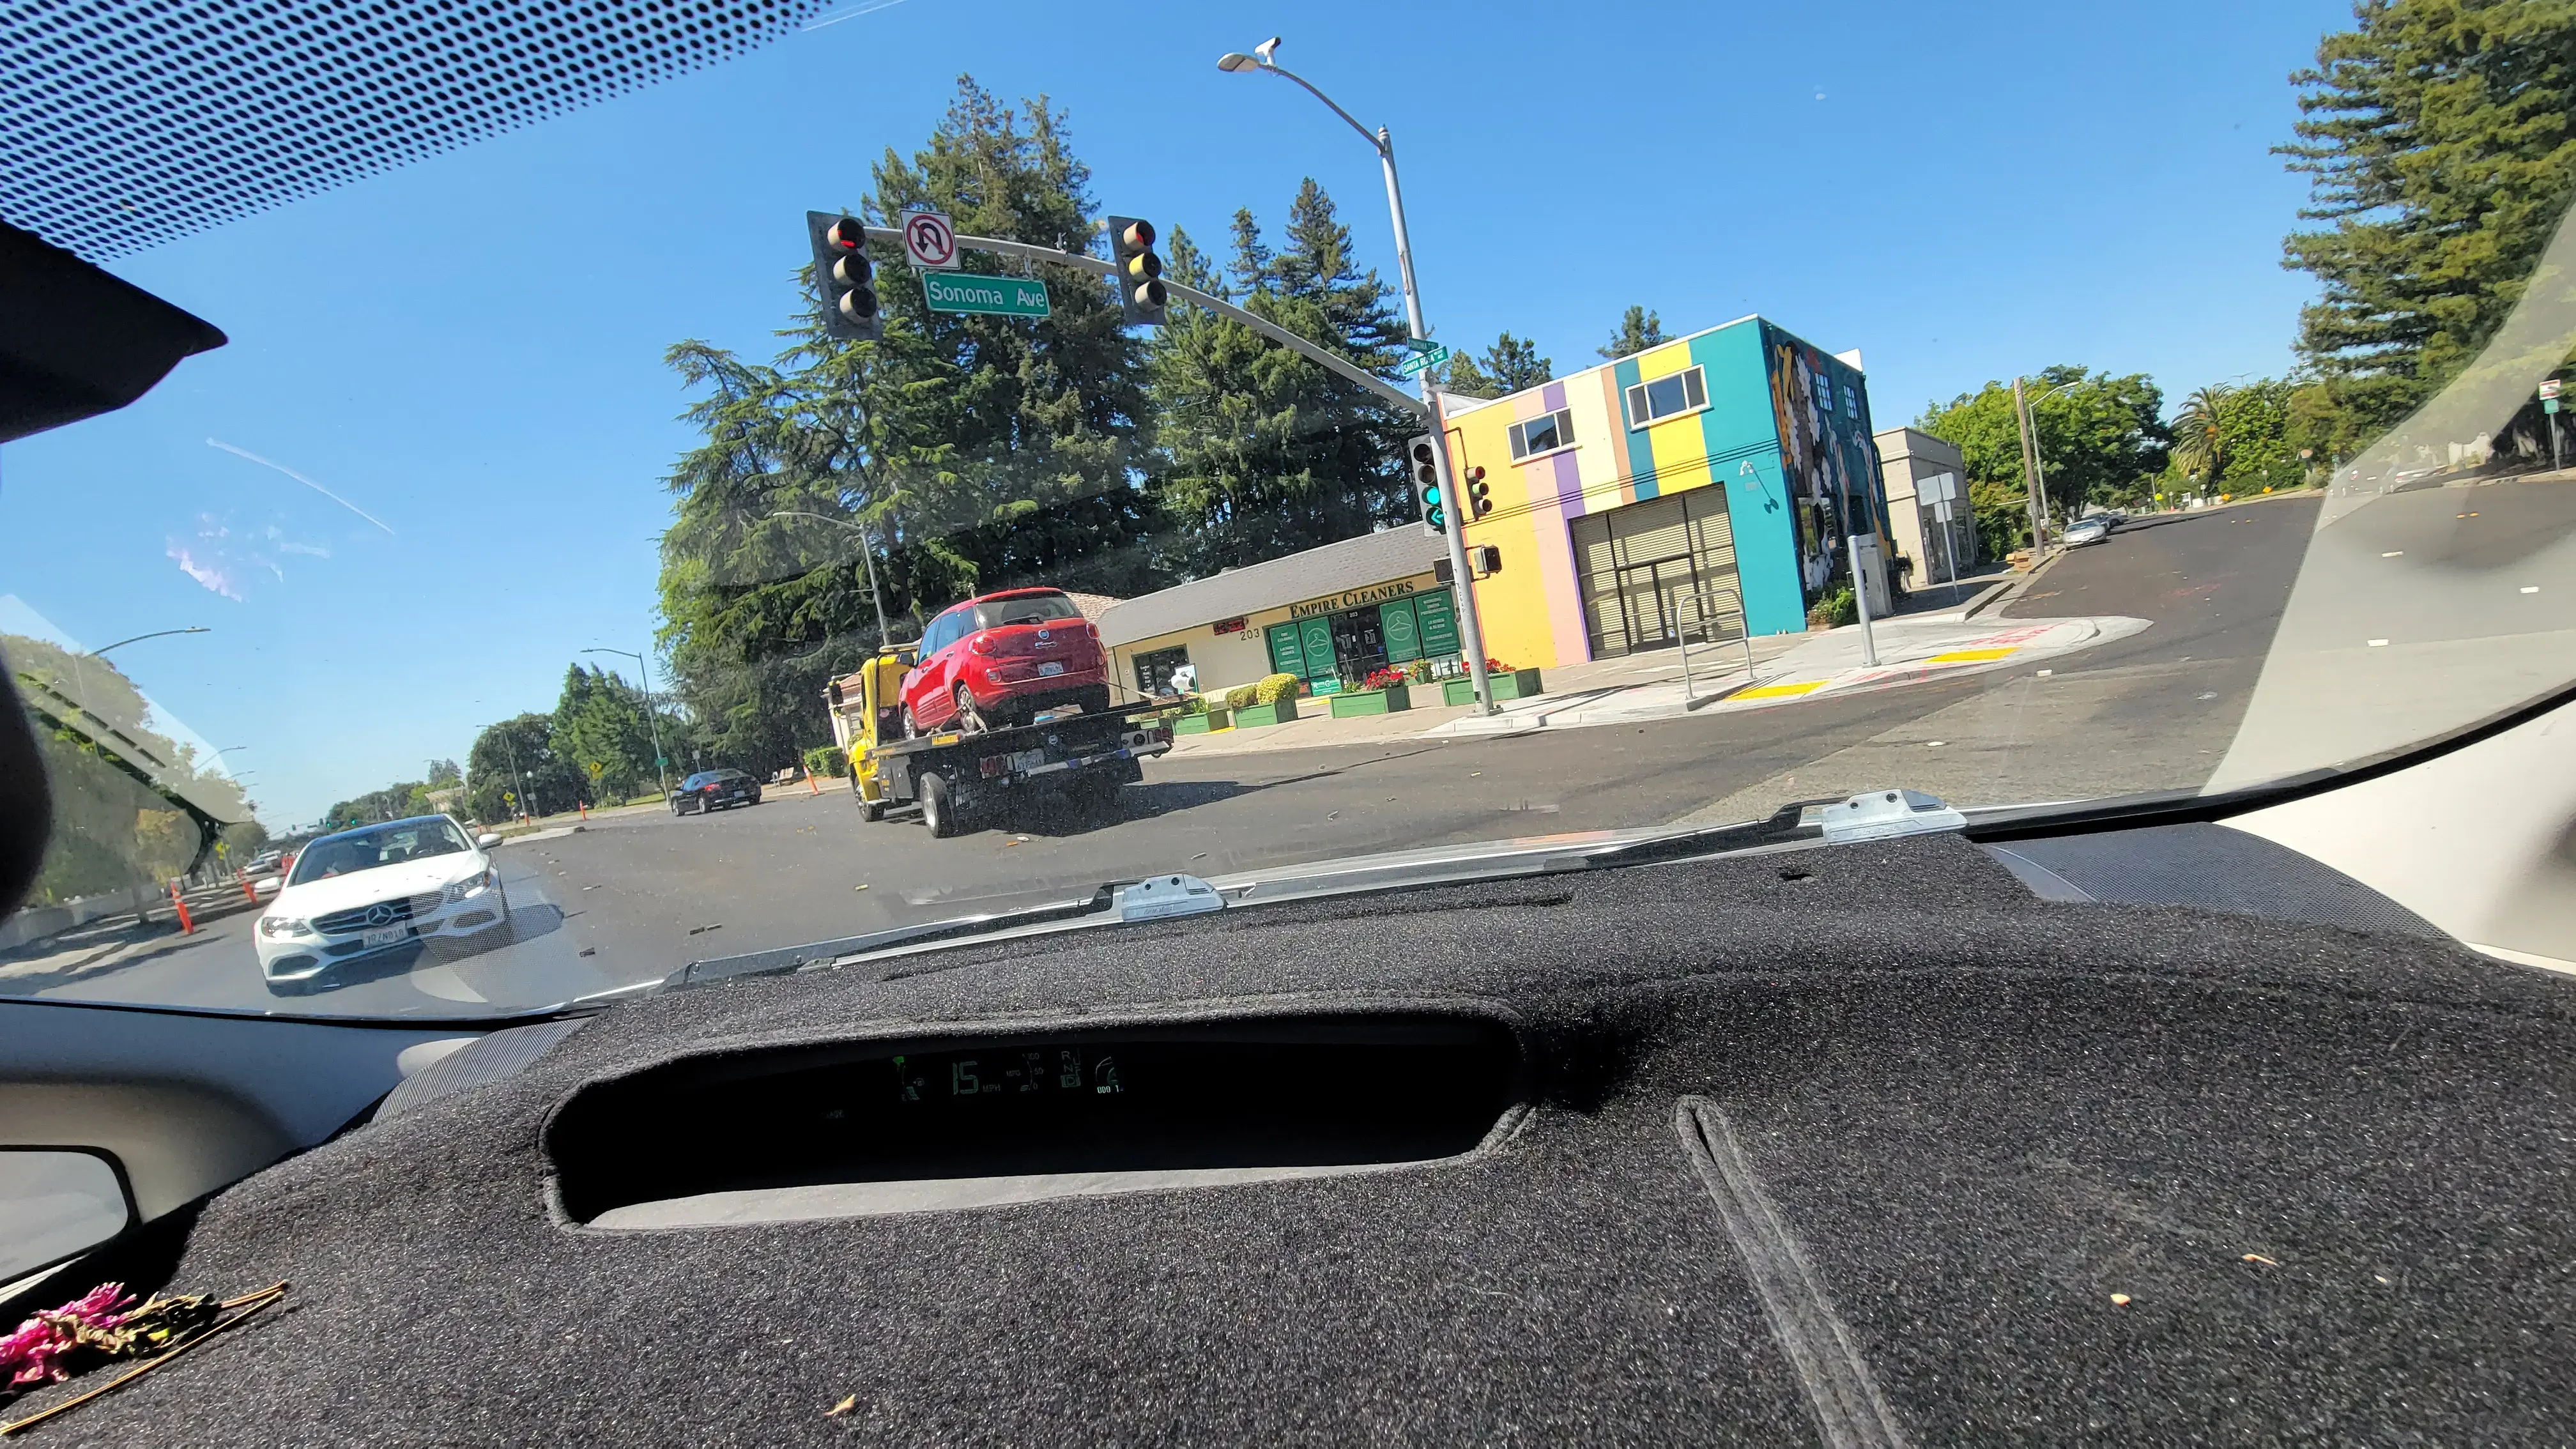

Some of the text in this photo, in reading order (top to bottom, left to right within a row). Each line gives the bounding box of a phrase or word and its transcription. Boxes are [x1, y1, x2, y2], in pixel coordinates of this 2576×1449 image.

[930, 281, 1045, 307] Sonoma Ave
[1404, 354, 1435, 372] SANTA ROA
[1289, 581, 1414, 618] EMPIRE CLEANERS
[1240, 628, 1260, 641] 203
[1061, 1050, 1071, 1061] R
[953, 1061, 979, 1096] 15
[983, 1083, 1000, 1093] MPH
